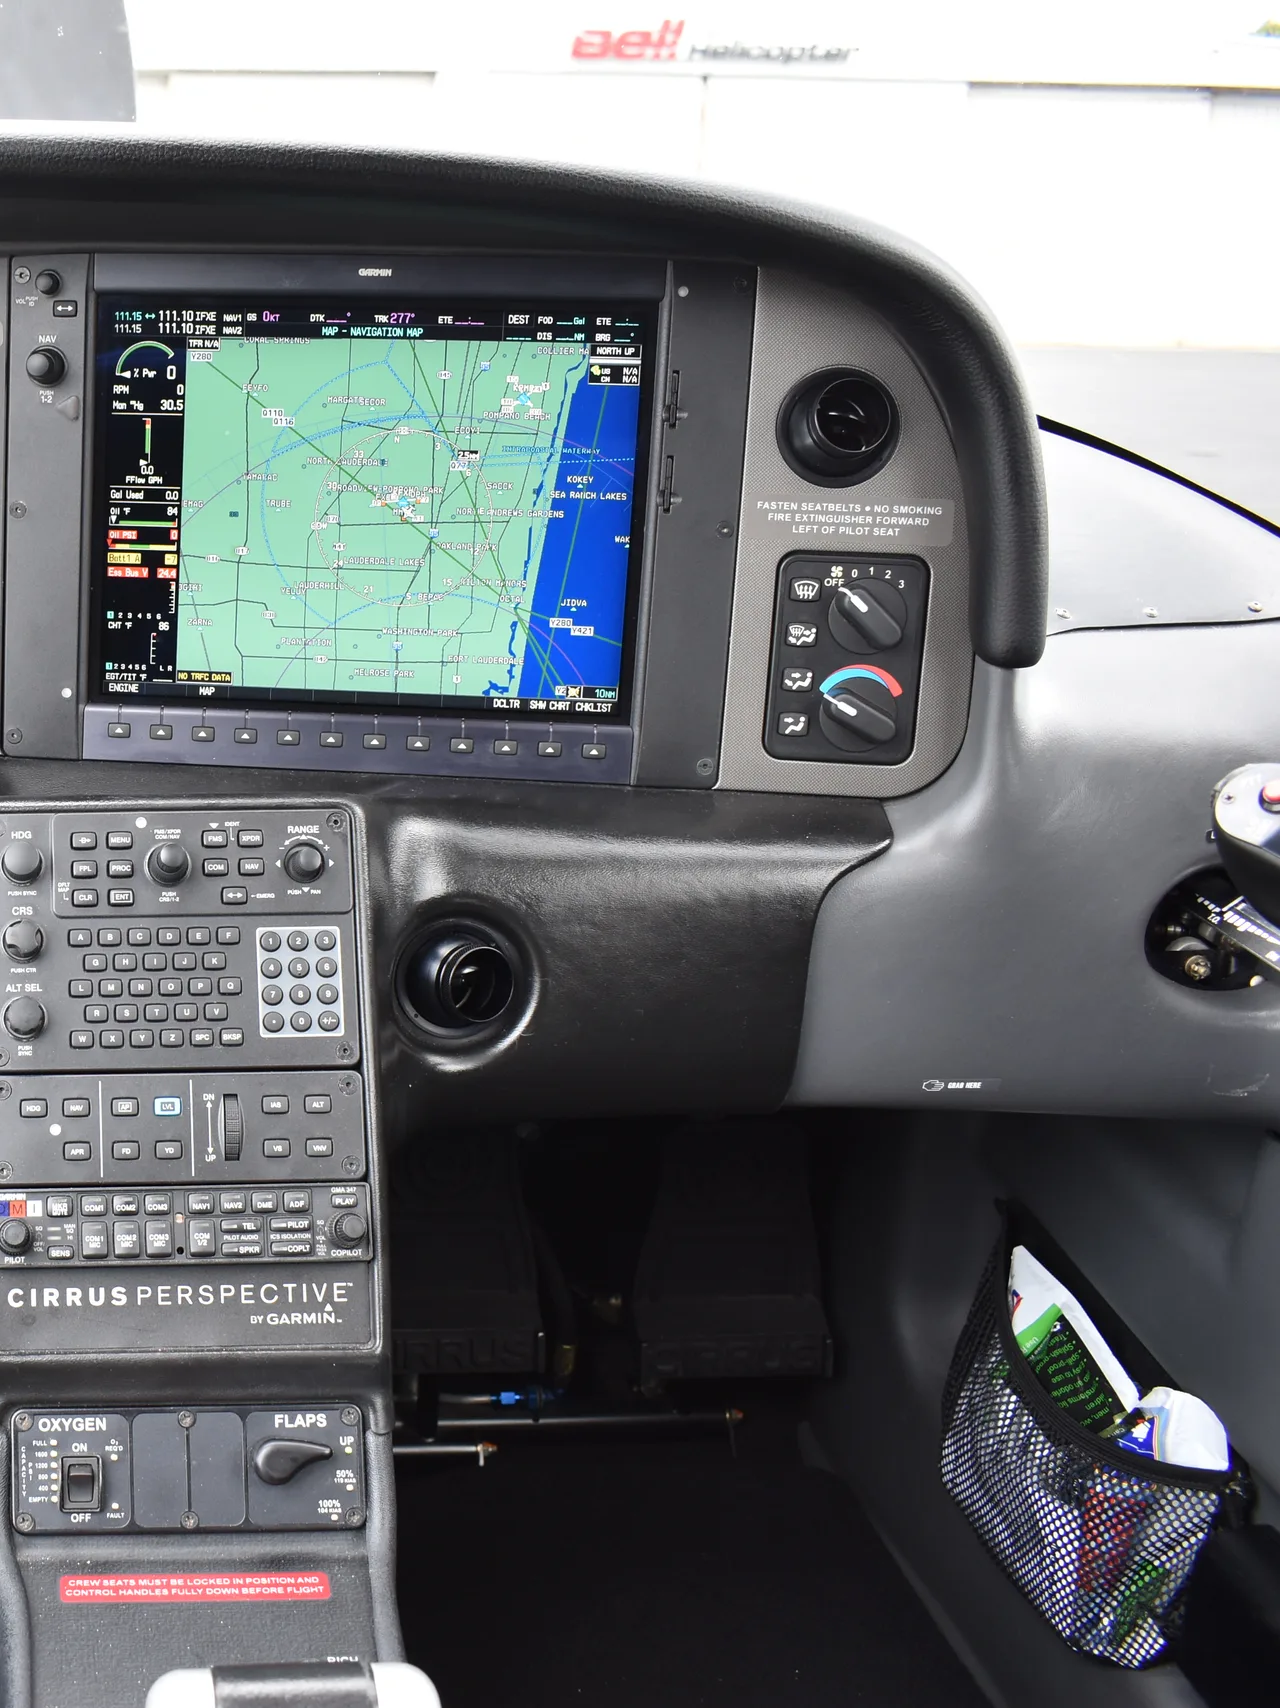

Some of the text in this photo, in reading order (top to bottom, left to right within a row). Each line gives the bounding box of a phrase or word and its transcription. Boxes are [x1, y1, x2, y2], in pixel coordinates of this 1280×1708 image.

[359, 268, 392, 276] GARMIN
[114, 311, 242, 322] 111.15 111.10 IFXE NAV1
[508, 315, 529, 325] DEST
[114, 323, 242, 335] 111.15 111.10 IFXE NAV2
[322, 327, 340, 336] MAP
[351, 327, 404, 337] NAVIGATION
[406, 328, 423, 337] MAP
[597, 347, 635, 356] NORTH UP
[757, 501, 942, 515] FASTEN SEATBELTS NO SMOKING
[768, 513, 929, 526] FIRE EXTINGUISHER FORWARD
[792, 525, 900, 536] LEFT OF PILOT SEAT
[851, 569, 858, 578] 0
[869, 566, 873, 575] 1
[885, 570, 891, 578] 2
[824, 578, 844, 587] OFF
[898, 580, 905, 589] 3
[561, 599, 587, 607] JIDVA
[178, 672, 187, 680] NO
[212, 673, 231, 681] DATA
[109, 684, 138, 692] ENGINE
[199, 687, 215, 695] MAP
[493, 700, 520, 708] DCLTR
[549, 701, 570, 710] CHRT
[575, 703, 612, 712] CHKLIST
[288, 826, 319, 834] RANGE
[12, 907, 33, 915] CRS
[8, 1287, 128, 1308] CIRRUS
[251, 1316, 262, 1324] BY
[39, 1418, 106, 1432] OXYGEN
[275, 1414, 327, 1428] FLAPS
[340, 1436, 354, 1445] UP
[72, 1443, 87, 1452] ON
[336, 1470, 353, 1478] 50%
[319, 1500, 341, 1508] 100%
[71, 1514, 91, 1522] OFF
